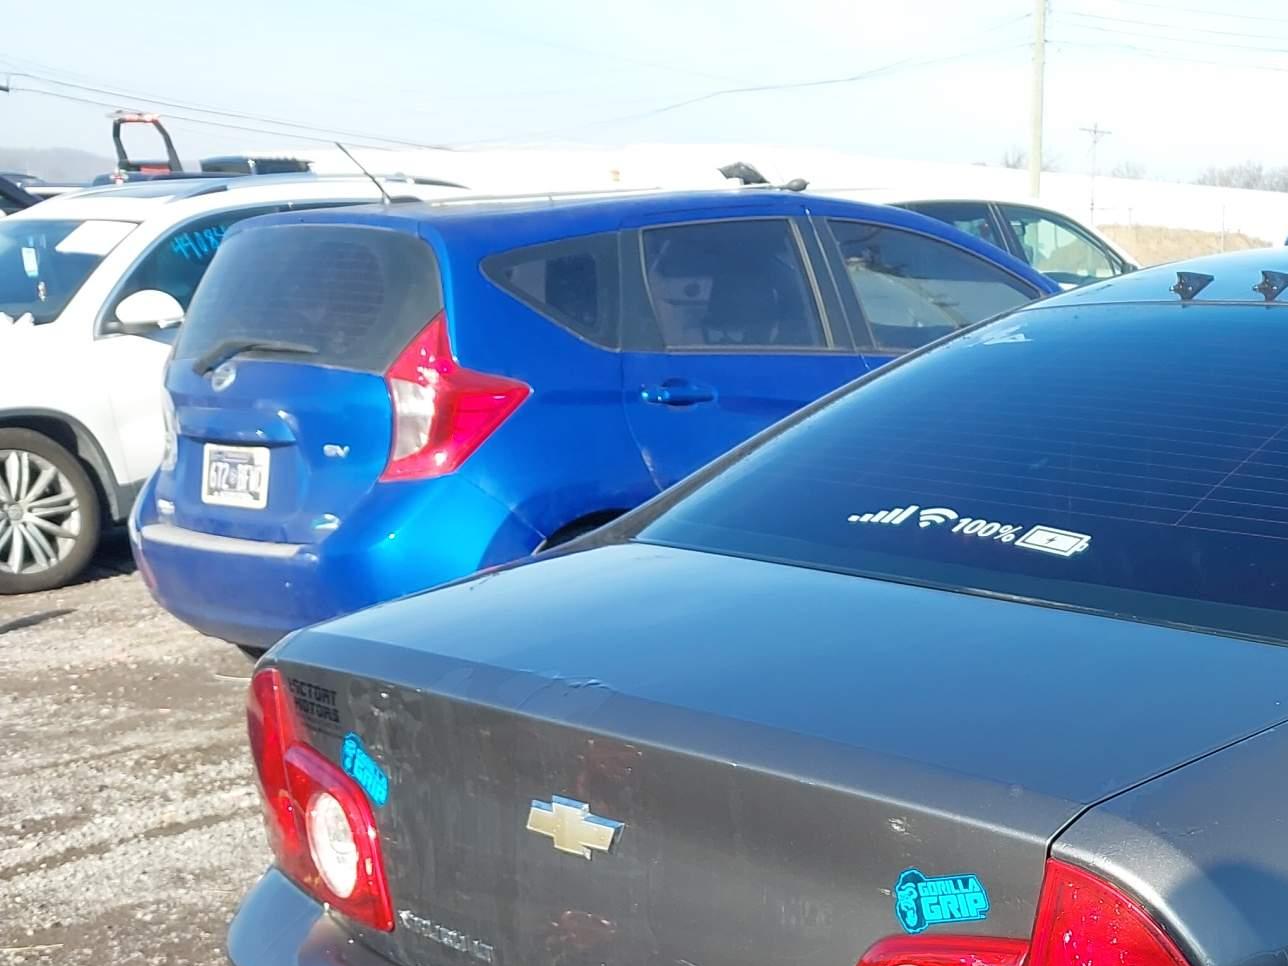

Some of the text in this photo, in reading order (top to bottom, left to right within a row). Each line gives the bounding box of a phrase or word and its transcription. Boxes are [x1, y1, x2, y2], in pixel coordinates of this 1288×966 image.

[323, 444, 350, 458] SV
[951, 517, 1023, 542] 100%
[917, 878, 981, 897] GORILLA
[920, 892, 986, 921] GRIP
